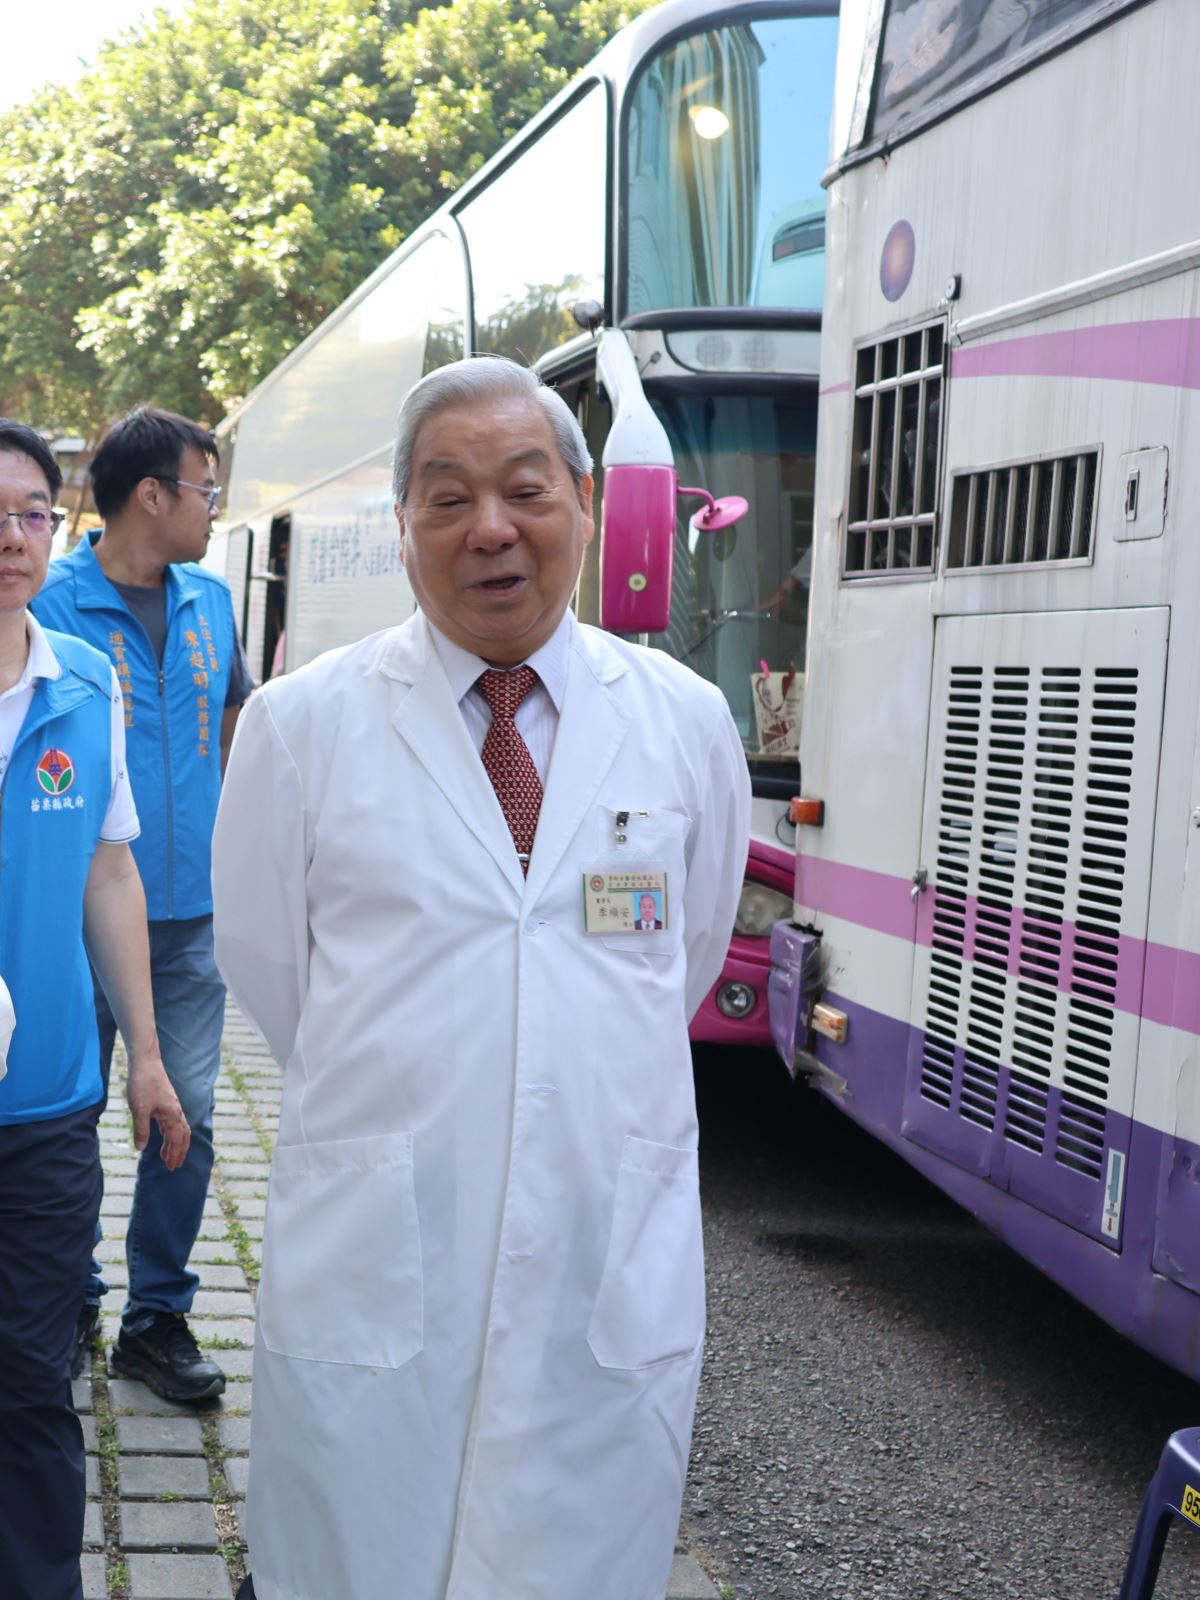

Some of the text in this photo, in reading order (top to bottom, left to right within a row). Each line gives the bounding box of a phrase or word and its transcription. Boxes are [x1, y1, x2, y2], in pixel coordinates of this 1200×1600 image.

[30, 795, 85, 812] 苗栗縣政府
[1185, 1491, 1200, 1520] 95
